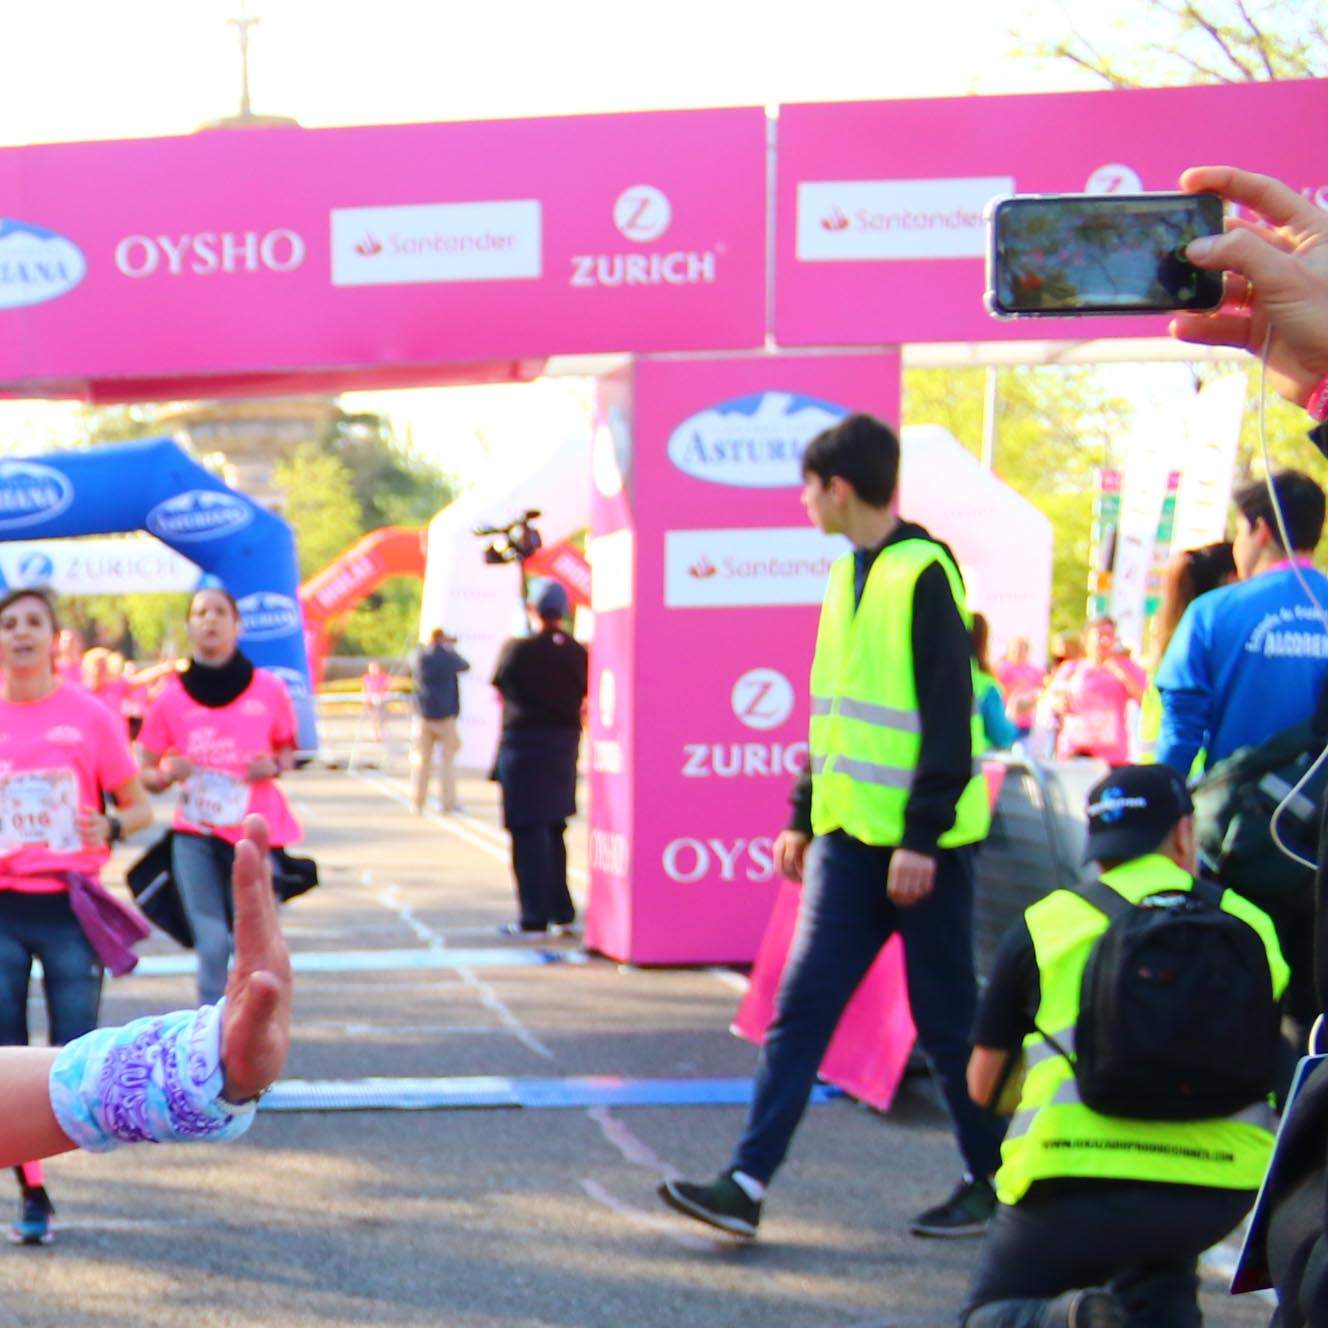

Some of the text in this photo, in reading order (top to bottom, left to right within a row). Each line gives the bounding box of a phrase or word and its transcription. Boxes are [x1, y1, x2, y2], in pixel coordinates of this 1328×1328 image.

[854, 206, 987, 233] Santande
[114, 228, 306, 279] OYSHO
[388, 229, 516, 256] Santander
[569, 250, 717, 288] ZURICH
[684, 430, 804, 464] ASTURI
[680, 743, 812, 780] ZURIC
[661, 837, 777, 884] OYS
